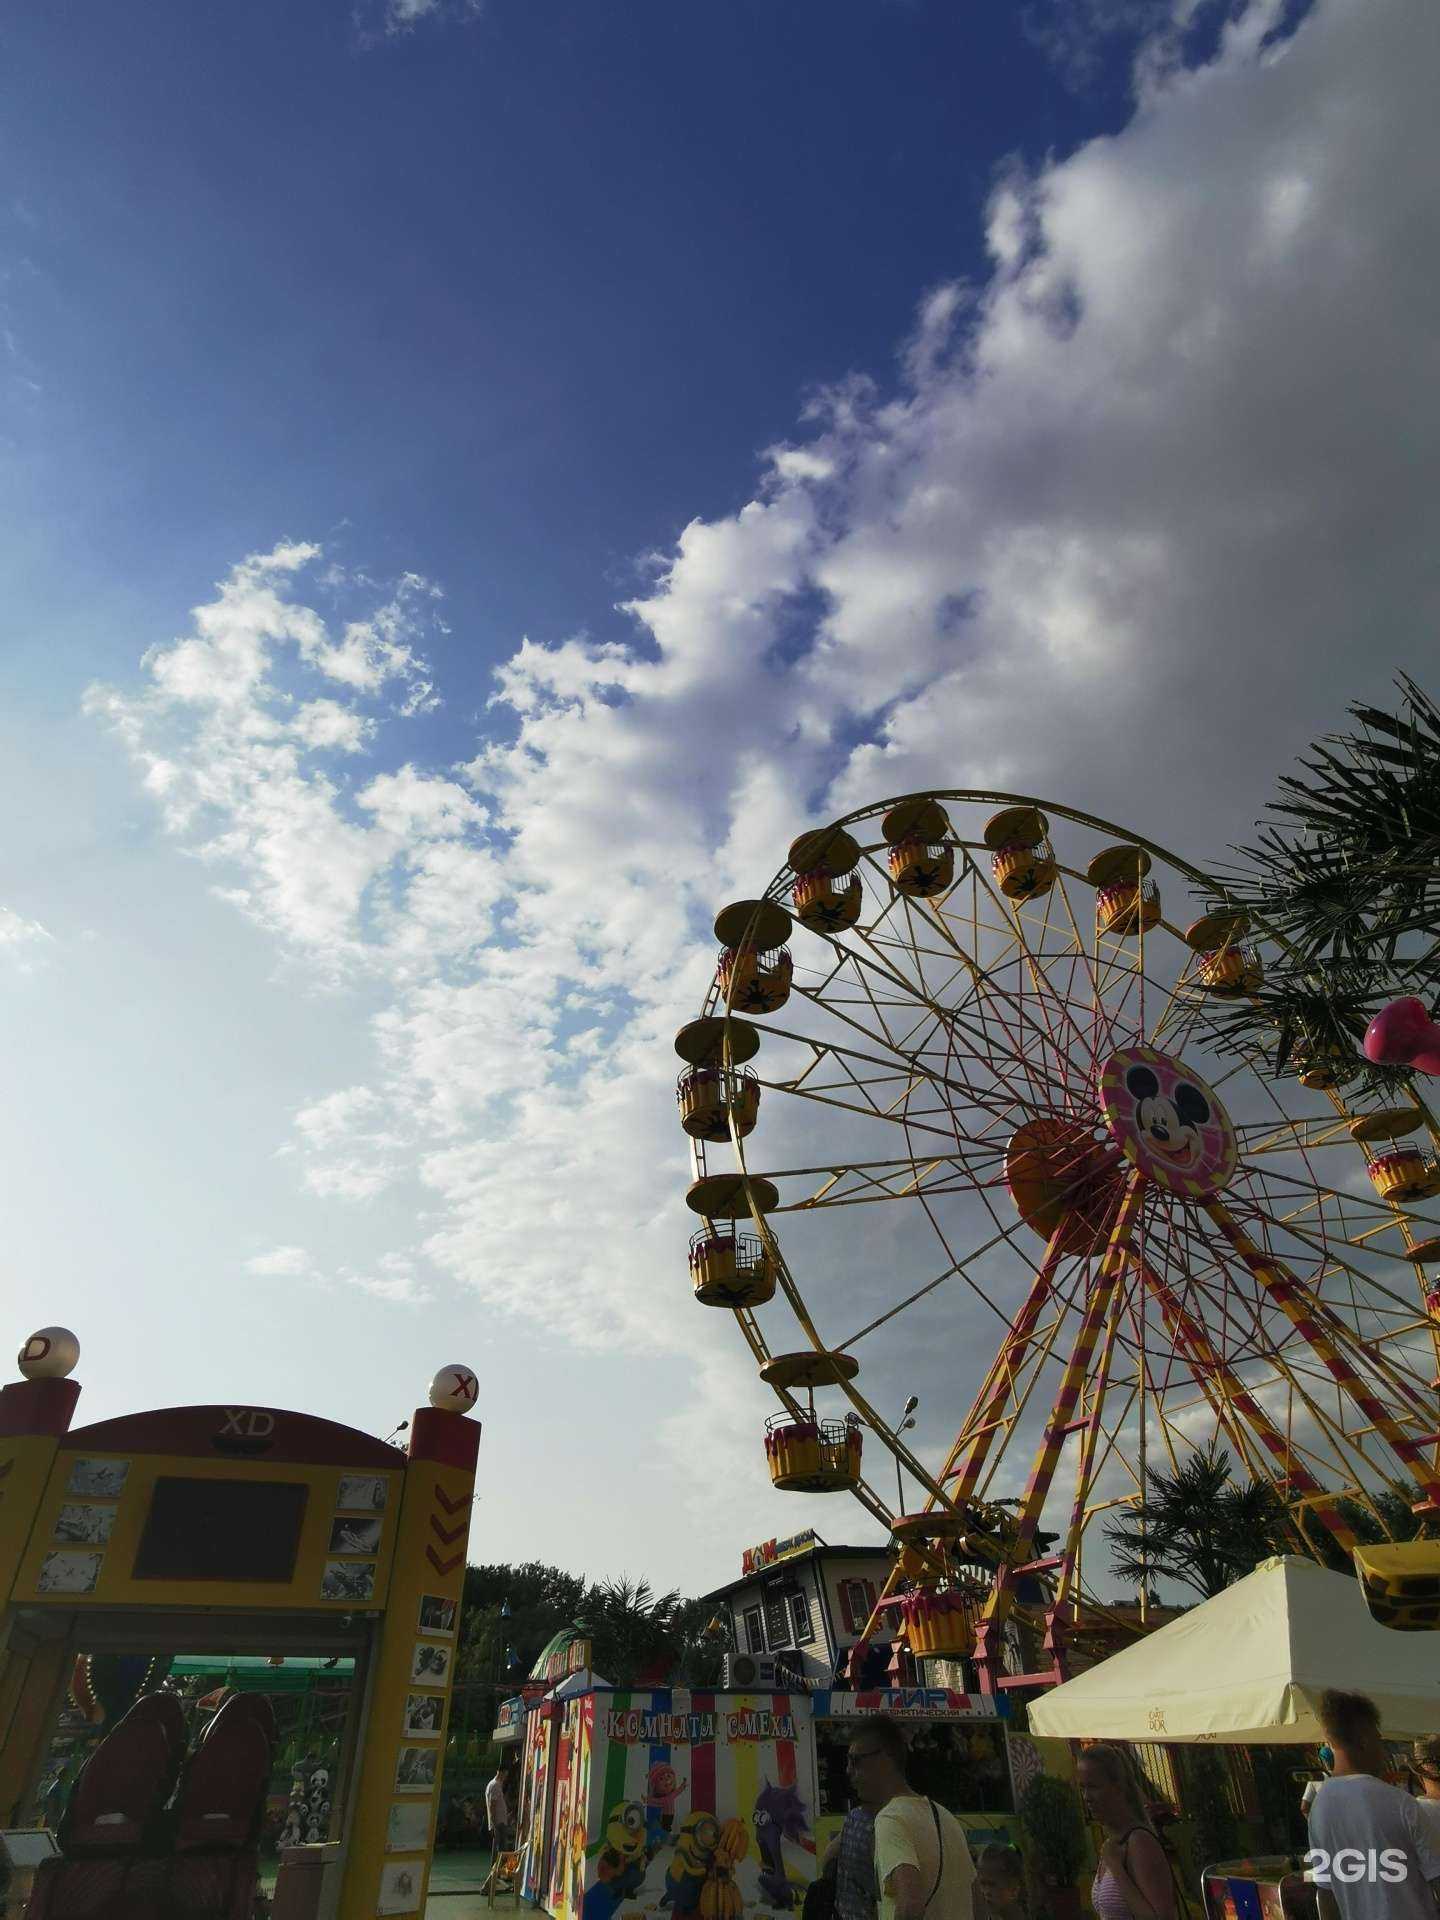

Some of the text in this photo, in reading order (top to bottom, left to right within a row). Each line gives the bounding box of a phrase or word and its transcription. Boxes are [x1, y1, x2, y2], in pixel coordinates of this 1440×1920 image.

[218, 1408, 275, 1436] XD
[880, 1688, 948, 1708] ТИР
[607, 1710, 716, 1740] КОМНАТА
[728, 1709, 796, 1740] СМЕХА
